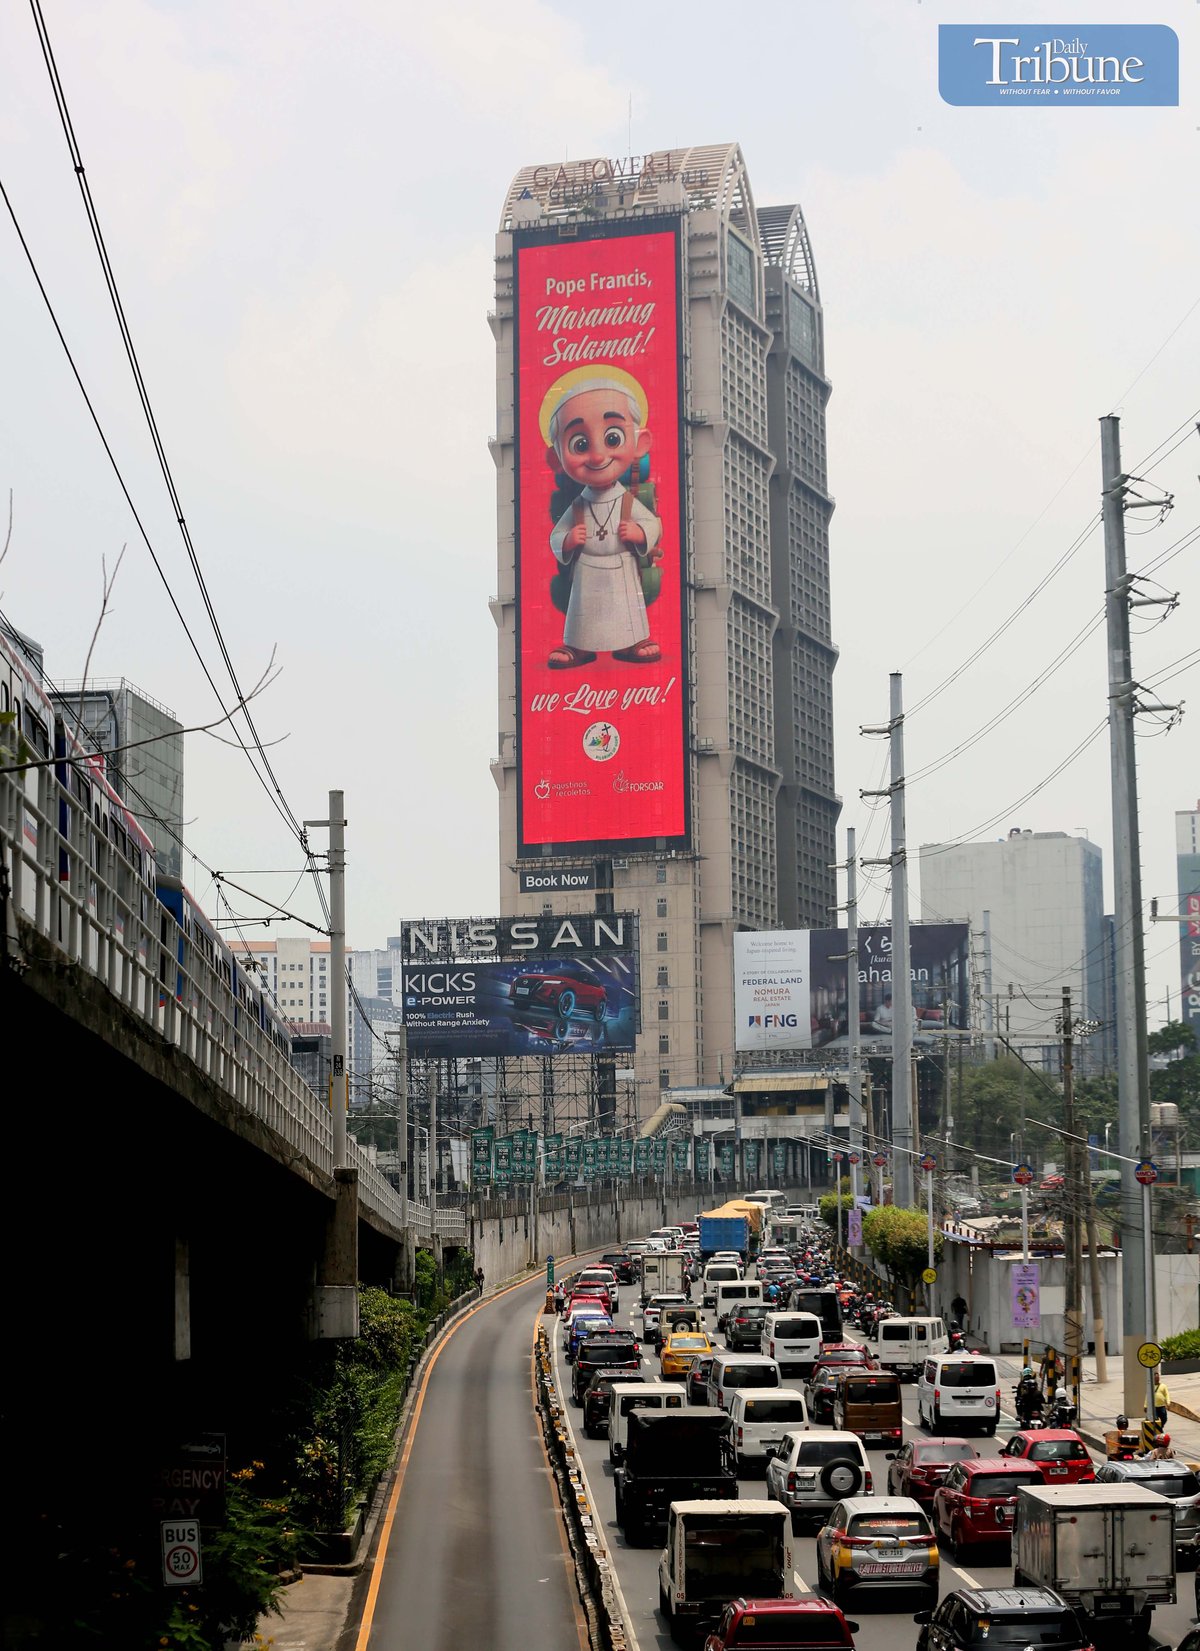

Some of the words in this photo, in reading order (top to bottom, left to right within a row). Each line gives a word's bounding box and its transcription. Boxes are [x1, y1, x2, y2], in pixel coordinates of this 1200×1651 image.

[546, 277, 586, 298] Pope
[590, 268, 653, 291] Francis,
[535, 297, 656, 335] Maraming
[543, 327, 656, 366] Salamat!
[531, 692, 560, 712] we
[562, 683, 620, 715] Love
[620, 677, 676, 711] you!
[525, 874, 558, 888] Book
[560, 873, 589, 887] Now
[409, 918, 624, 954] NISSAN
[405, 972, 476, 993] KICKS
[742, 978, 778, 986] FEDERAL
[754, 987, 791, 996] NOMURA
[406, 995, 476, 1006] e-POWER
[406, 1012, 426, 1020] 100%
[456, 1010, 475, 1018] Rush
[764, 1014, 798, 1028] FNG
[406, 1019, 436, 1027] Without
[437, 1019, 461, 1028] Range
[462, 1018, 490, 1026] Anxiety
[165, 1528, 196, 1543] BUS
[172, 1551, 191, 1564] 50
